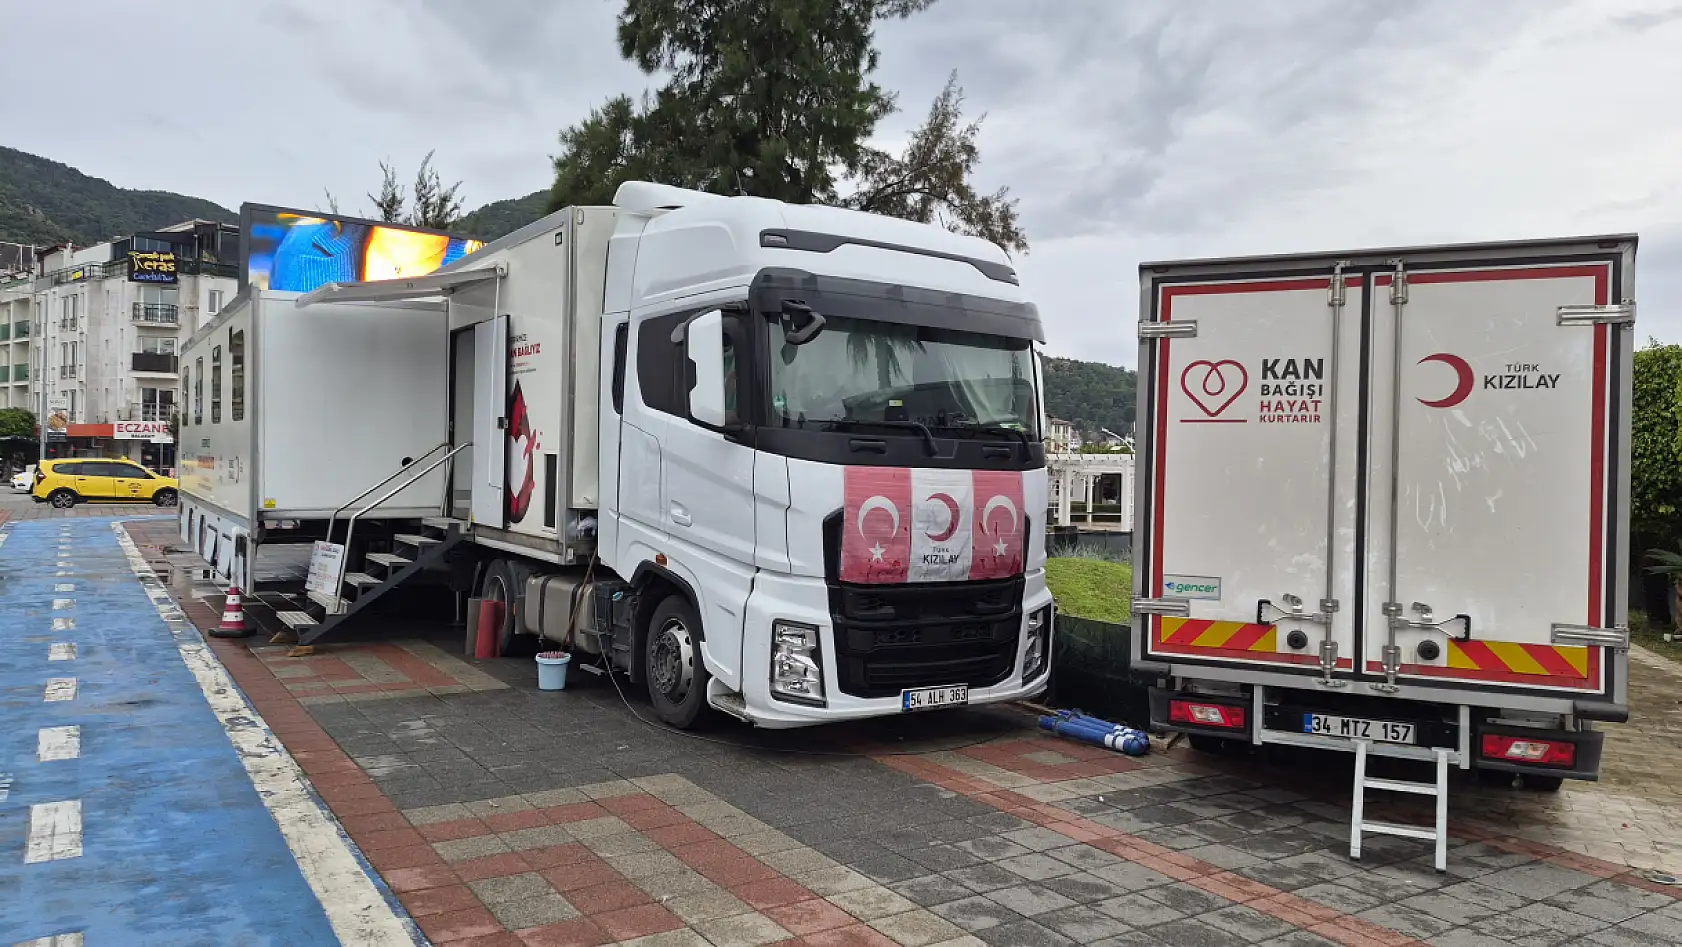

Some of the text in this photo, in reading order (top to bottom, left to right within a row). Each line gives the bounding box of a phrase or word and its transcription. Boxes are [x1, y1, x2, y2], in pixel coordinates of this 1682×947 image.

[1262, 358, 1324, 380] KAN
[1505, 362, 1540, 373] TÜRK
[1484, 374, 1561, 390] KIZILAY
[1261, 381, 1323, 399] BAĞIŞI
[1260, 400, 1322, 412] HAYAT
[1259, 414, 1321, 423] KURTARIR
[117, 423, 168, 433] ECZANE
[923, 554, 959, 564] KIZILAY
[1175, 583, 1217, 593] gencer
[911, 689, 966, 706] 54 ALH 363
[1312, 716, 1411, 741] 34 MTZ 157
